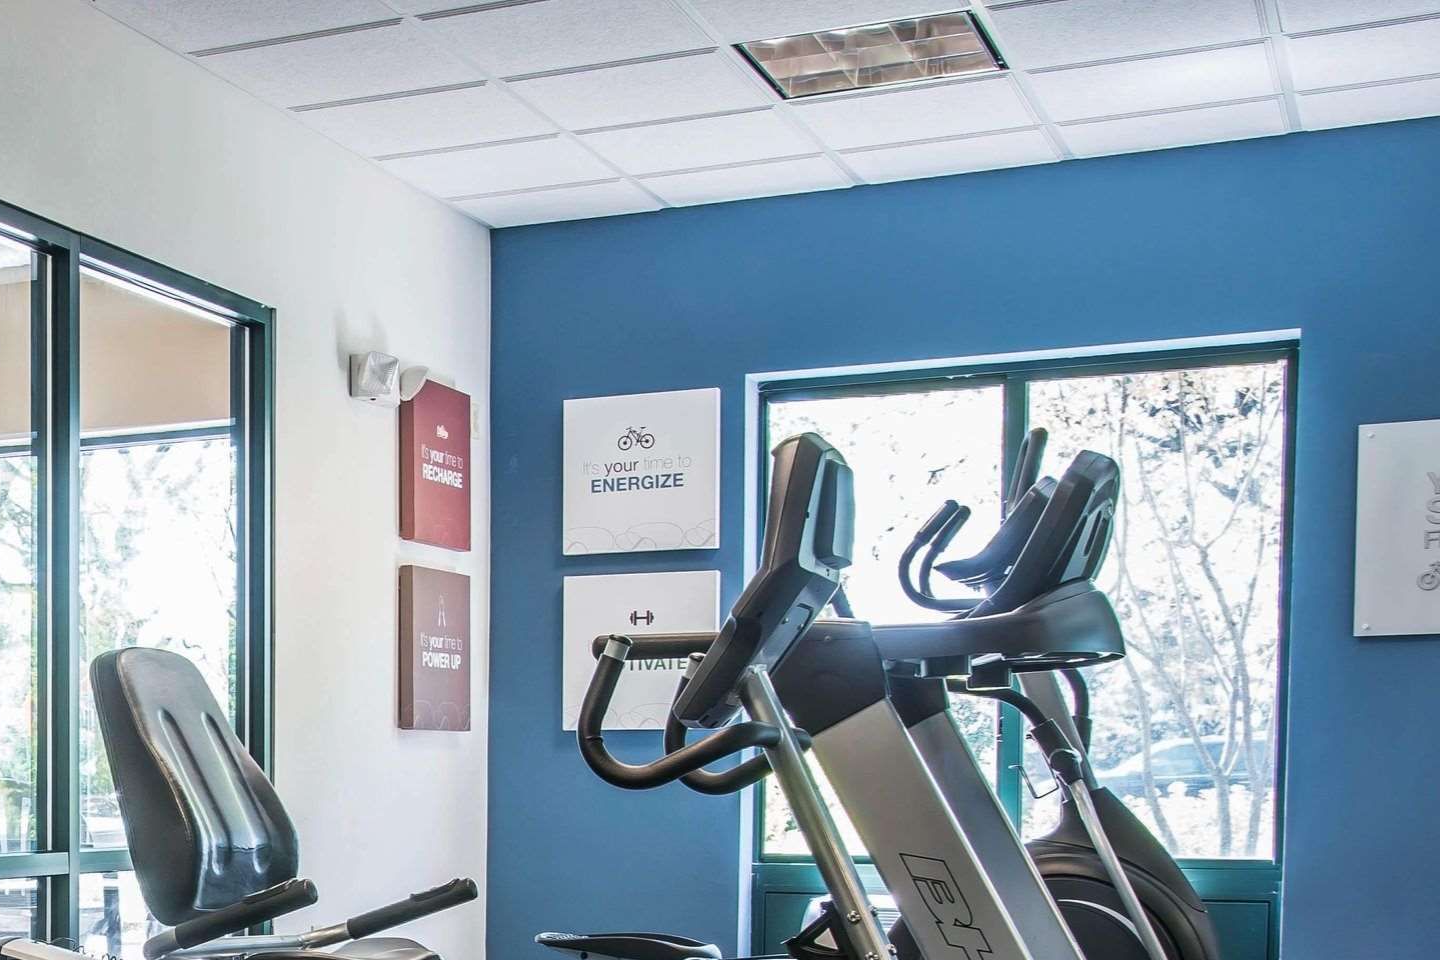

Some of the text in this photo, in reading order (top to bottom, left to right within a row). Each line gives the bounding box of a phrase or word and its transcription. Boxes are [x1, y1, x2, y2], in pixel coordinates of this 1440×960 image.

[430, 449, 444, 464] your
[583, 455, 692, 477] It's your time to
[422, 463, 463, 488] RECHARGE
[591, 473, 684, 493] ENERGIZE
[429, 636, 443, 651] your
[422, 652, 461, 670] POWER UP
